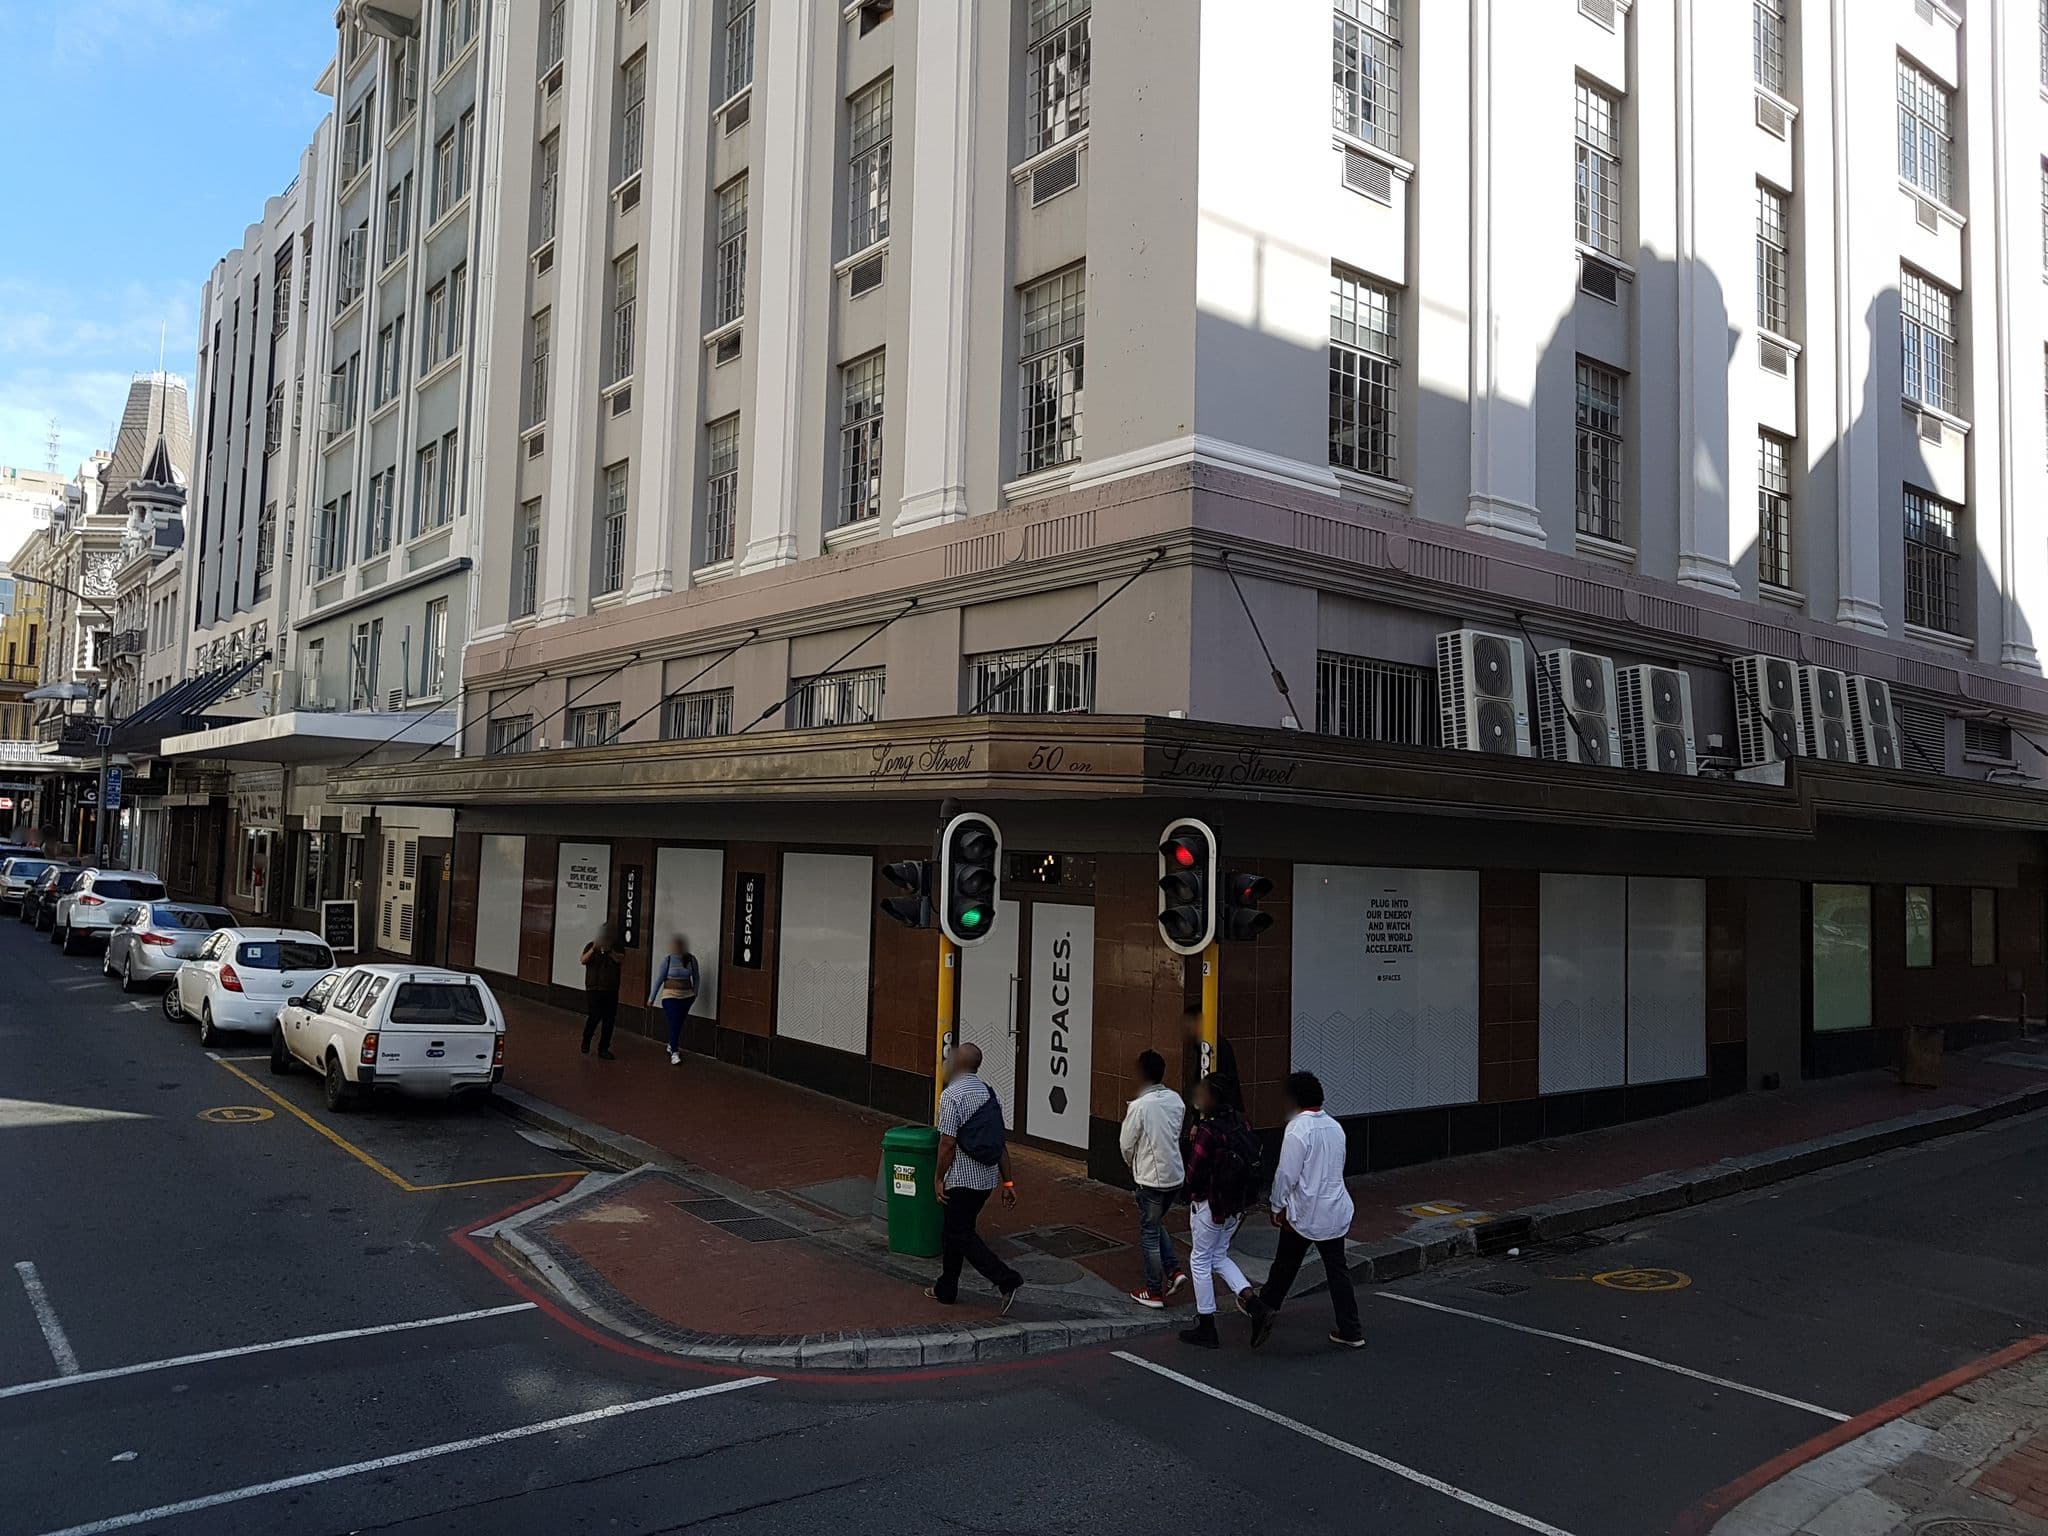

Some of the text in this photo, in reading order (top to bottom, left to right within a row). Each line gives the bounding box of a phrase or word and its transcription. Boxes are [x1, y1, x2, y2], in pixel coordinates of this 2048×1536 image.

[870, 737, 975, 783] Long Street
[1027, 746, 1094, 772] 50 on
[1160, 742, 1297, 792] Long Street
[625, 869, 635, 928] SPACES.
[1370, 899, 1409, 908] PLUG INTO
[744, 878, 754, 945] SPACES.
[1366, 910, 1412, 919] OUR ENERGY
[1368, 922, 1411, 930] AND WATCH
[1366, 933, 1413, 942] YOUR WORLD
[1365, 944, 1414, 953] ACCELERATE.
[947, 955, 953, 966] 1
[1202, 962, 1208, 974] 2
[1050, 931, 1071, 1078] SPACES.
